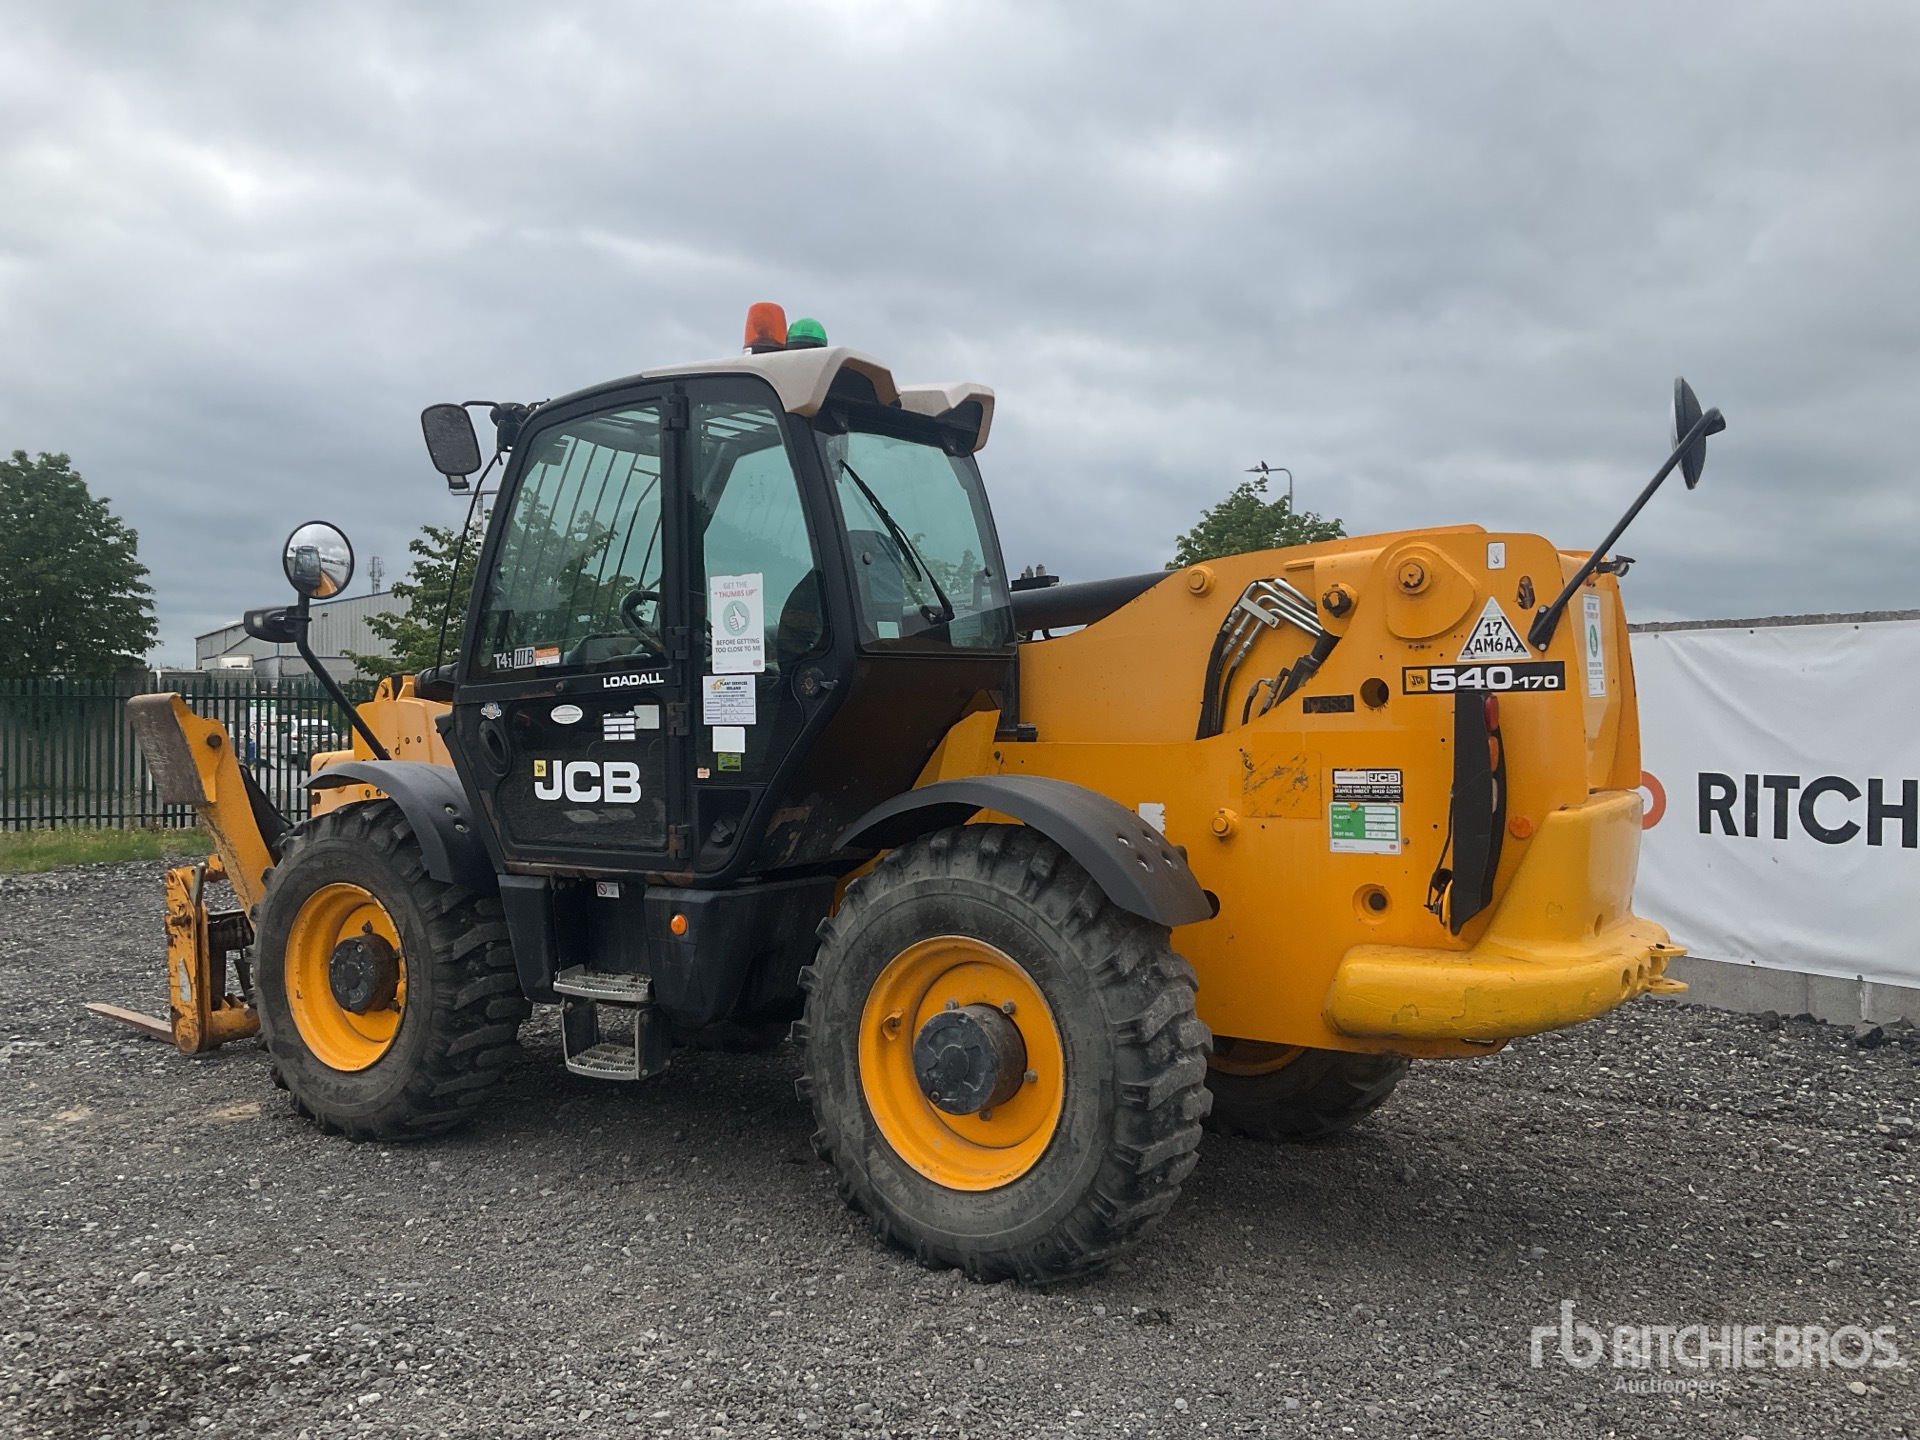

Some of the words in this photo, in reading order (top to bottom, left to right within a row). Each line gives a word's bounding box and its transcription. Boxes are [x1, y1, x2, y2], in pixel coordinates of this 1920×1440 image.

[736, 580, 748, 589] THE
[1484, 621, 1502, 637] 17
[737, 637, 760, 645] GETTING
[1474, 636, 1514, 653] AM6A
[602, 672, 665, 688] LOADALL
[534, 760, 642, 804] JCB
[1369, 772, 1399, 783] JCB
[1698, 771, 1919, 849] RITCH
